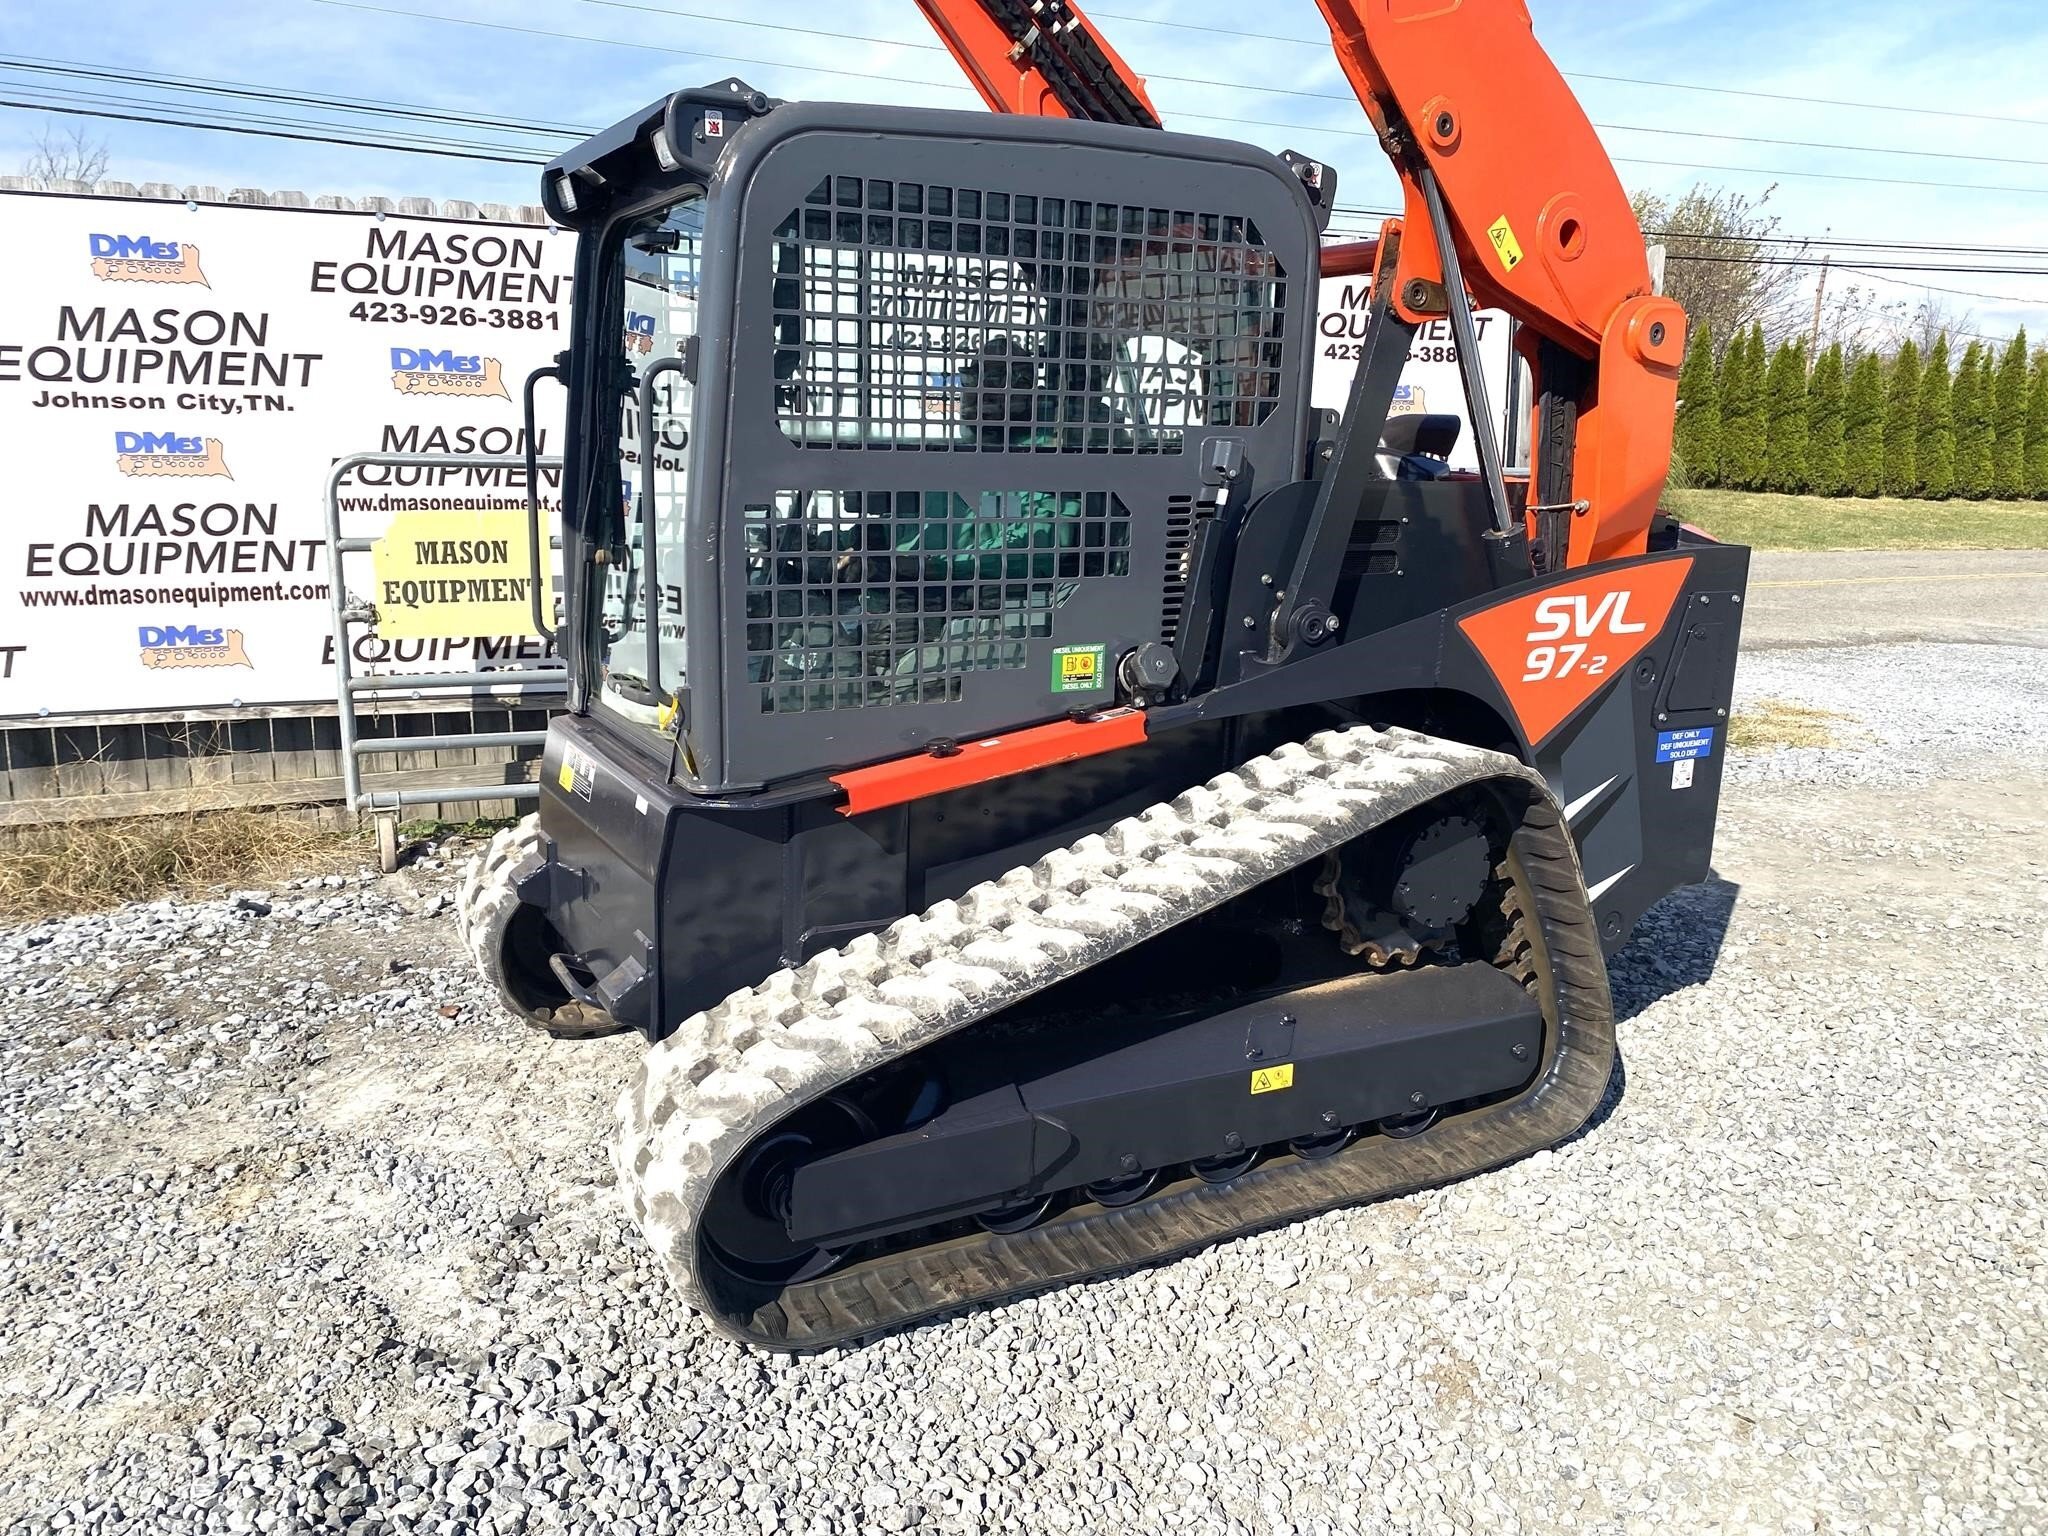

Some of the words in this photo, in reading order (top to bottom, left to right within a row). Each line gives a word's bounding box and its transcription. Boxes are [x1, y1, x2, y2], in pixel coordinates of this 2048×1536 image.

[365, 228, 543, 269] MASON
[57, 306, 268, 346] MASON
[349, 302, 559, 330] 423-926-3881
[0, 346, 323, 387] EQUIPMENT
[32, 391, 165, 409] Johnson
[380, 425, 547, 455] MASON
[85, 503, 277, 536] MASON
[26, 540, 326, 576] EQUIPMENT
[415, 540, 508, 565] MASON
[20, 582, 330, 607] www.dmasonequipment.com
[1526, 590, 1647, 642] SVL
[1522, 643, 1608, 682] 97-2
[1660, 742, 1673, 751] DEF
[1673, 739, 1710, 749] UNIQUEMENT
[1672, 732, 1683, 740] DEF
[1684, 731, 1700, 739] ONLY
[1670, 750, 1685, 759] SOLO
[1686, 748, 1698, 757] DEF
